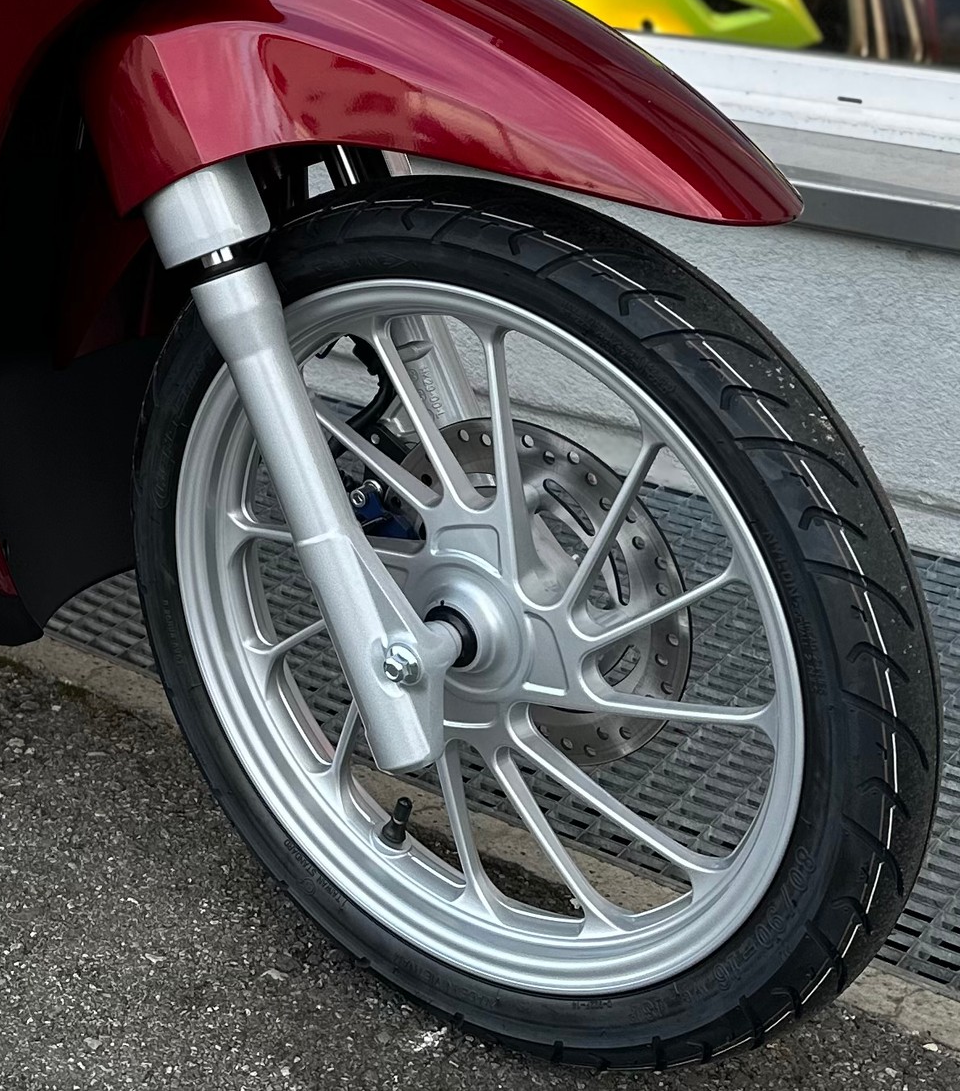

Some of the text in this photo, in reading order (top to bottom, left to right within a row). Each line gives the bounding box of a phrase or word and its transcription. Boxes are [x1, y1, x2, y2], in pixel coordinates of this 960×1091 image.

[762, 531, 800, 597] NYLON
[282, 838, 344, 903] TAIWAN STANDARD
[711, 845, 817, 988] 80/90-16
